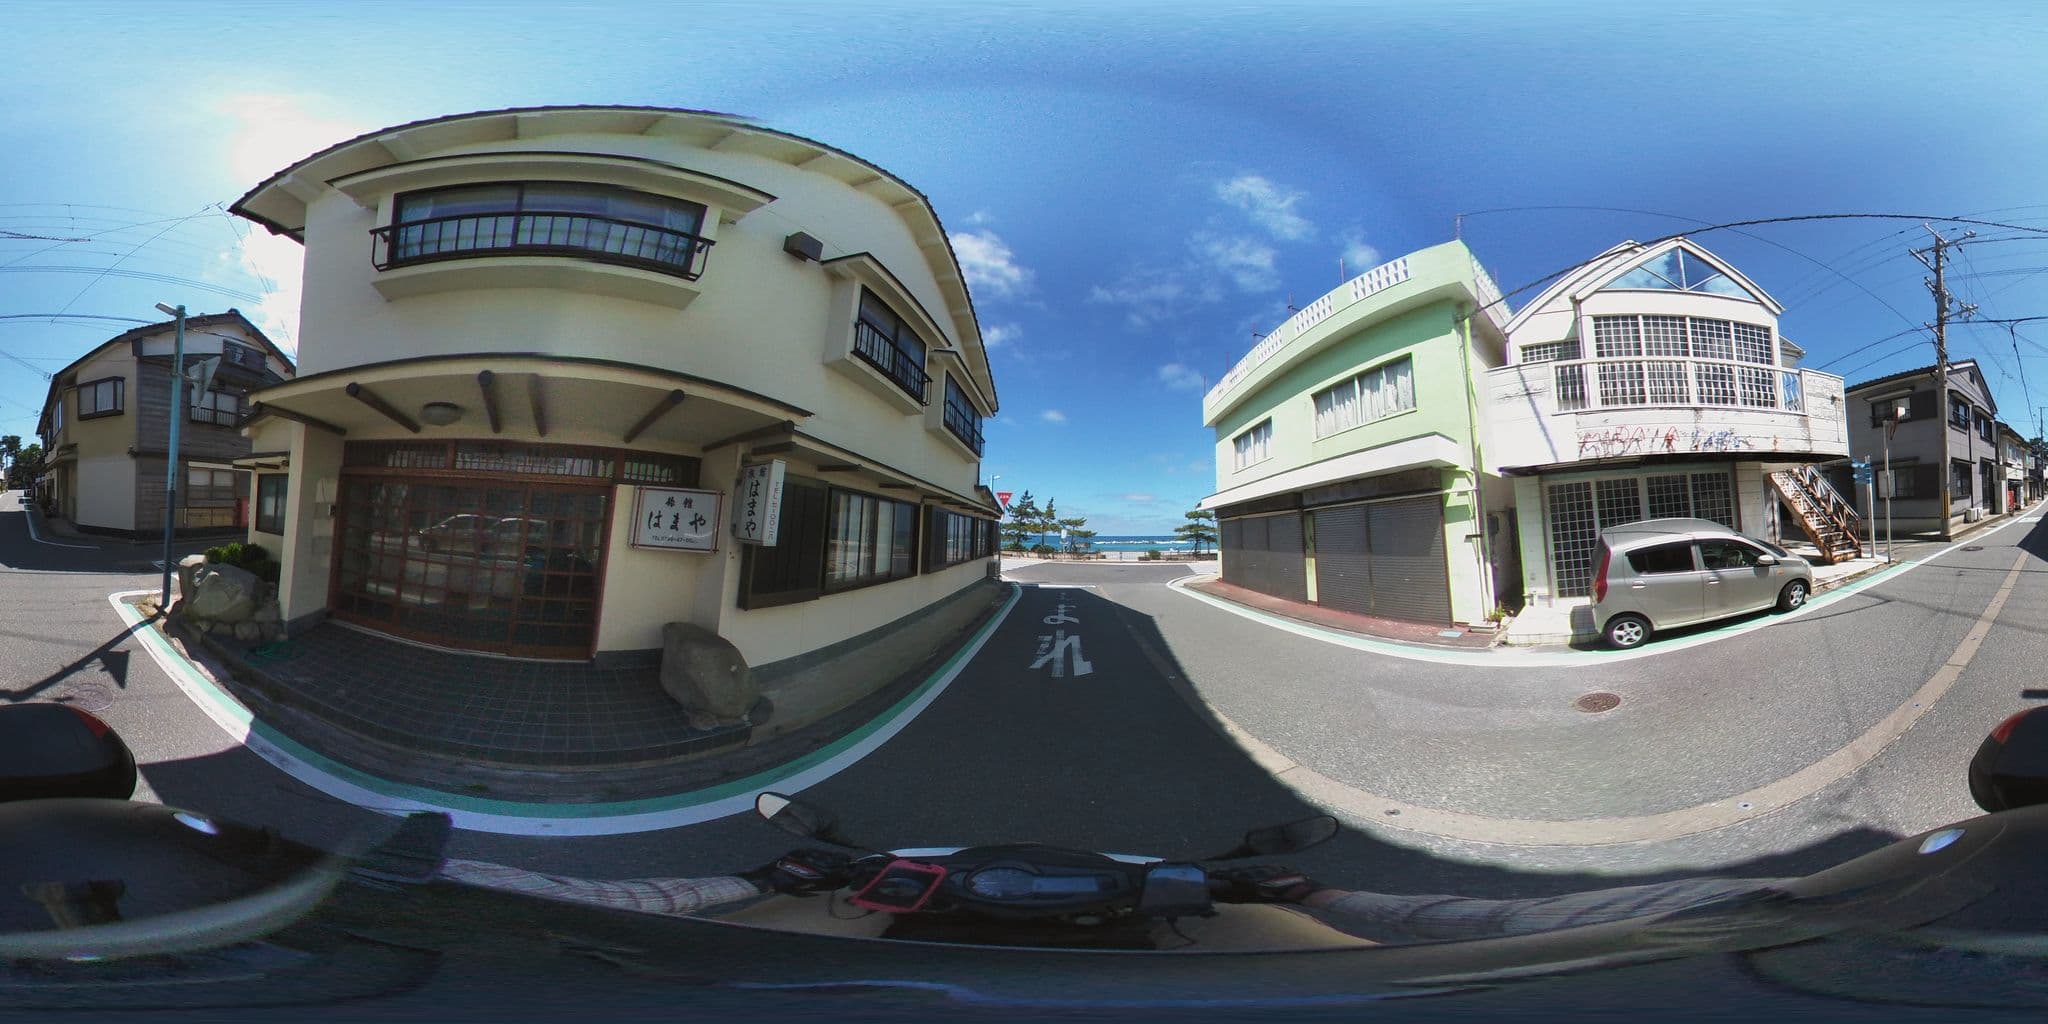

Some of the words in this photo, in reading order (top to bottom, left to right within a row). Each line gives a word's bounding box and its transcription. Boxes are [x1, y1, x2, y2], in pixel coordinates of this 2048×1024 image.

[648, 510, 706, 534] はまや
[664, 496, 693, 508] 旅館
[744, 479, 760, 538] はまや
[1029, 592, 1094, 677] まれ
